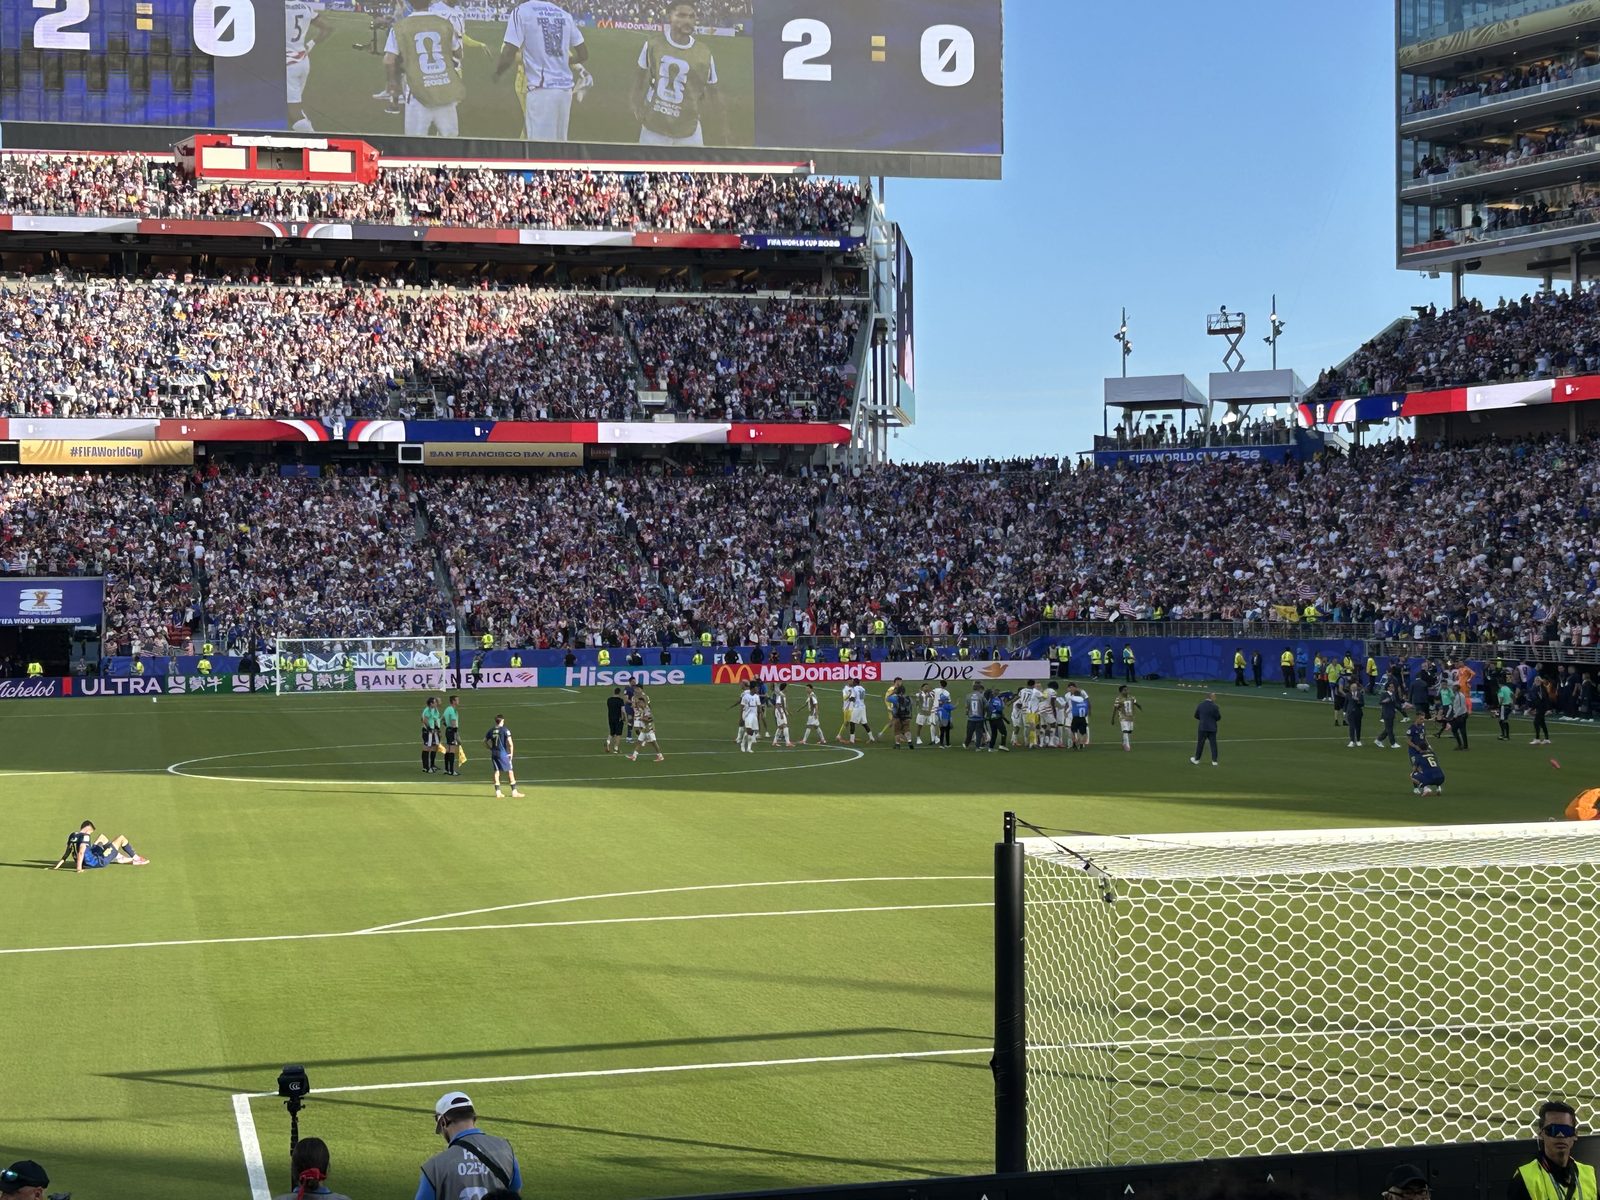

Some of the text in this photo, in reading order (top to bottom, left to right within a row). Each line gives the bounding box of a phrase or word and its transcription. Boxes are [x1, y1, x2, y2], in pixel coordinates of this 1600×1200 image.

[33, 0, 90, 50] 2
[193, 0, 256, 57] 0
[291, 15, 304, 42] 5
[614, 21, 662, 32] McDonald's
[781, 18, 832, 82] 2
[920, 24, 975, 87] 0
[805, 239, 817, 247] CUP
[70, 445, 143, 458] #FIFAWorldCup
[1129, 454, 1153, 463] FIFA
[361, 674, 408, 686] BANK
[412, 673, 433, 684] OF
[565, 667, 685, 687] Hisense
[759, 663, 877, 682] McDonald's
[923, 662, 974, 680] Dove
[81, 677, 162, 695] ULTRA
[1427, 756, 1438, 768] 6
